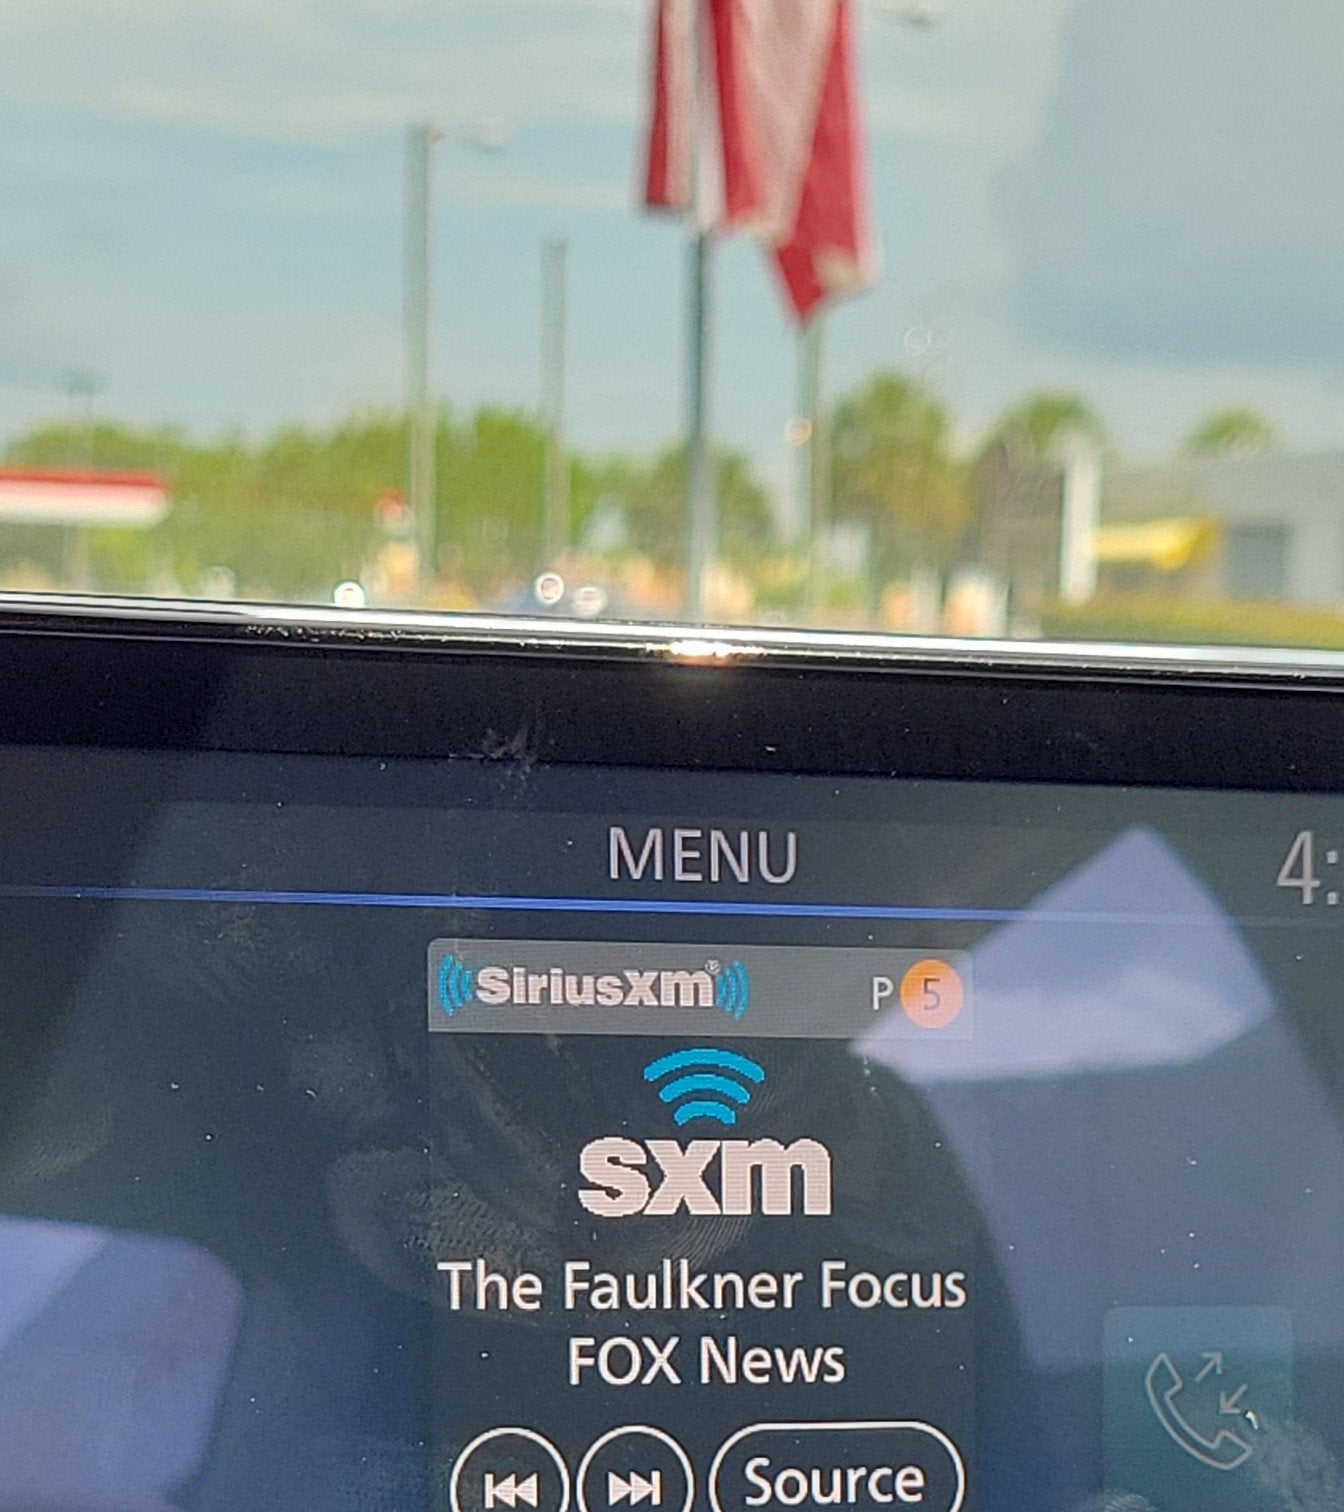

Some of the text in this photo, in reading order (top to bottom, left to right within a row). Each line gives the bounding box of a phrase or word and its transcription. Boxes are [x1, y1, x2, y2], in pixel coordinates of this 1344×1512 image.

[608, 826, 799, 885] MENU
[872, 977, 943, 1012] P 5
[577, 1136, 832, 1217] sxm
[438, 1258, 967, 1310] The Faulkner Focus
[568, 1336, 846, 1386] FOX News
[744, 1457, 925, 1507] Source
